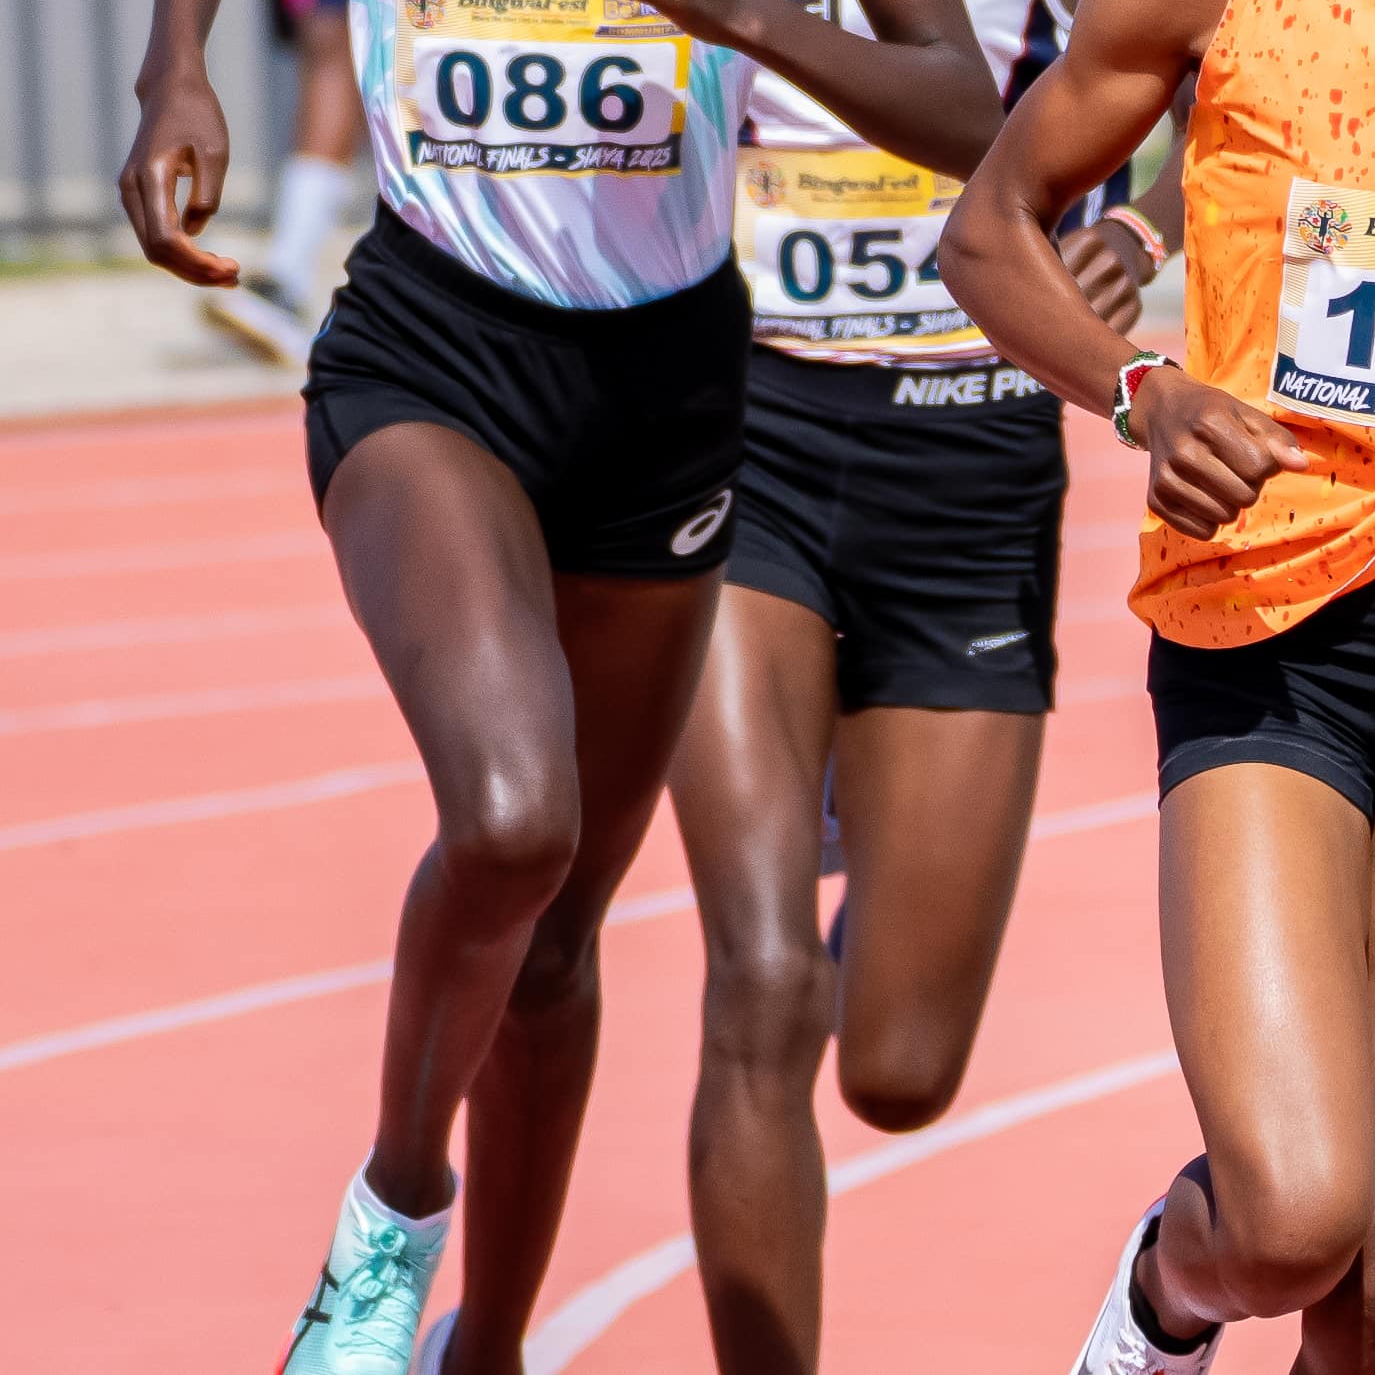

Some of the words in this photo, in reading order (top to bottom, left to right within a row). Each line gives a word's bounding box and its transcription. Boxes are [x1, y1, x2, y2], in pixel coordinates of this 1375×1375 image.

[436, 49, 645, 133] 086
[417, 142, 484, 166] NATIONAL
[486, 145, 549, 172] FINALS
[568, 145, 625, 172] SIAYA
[627, 146, 672, 171] 2025
[893, 373, 988, 404] NIKE
[991, 368, 1047, 400] PR
[1279, 371, 1370, 411] NATIONAL
